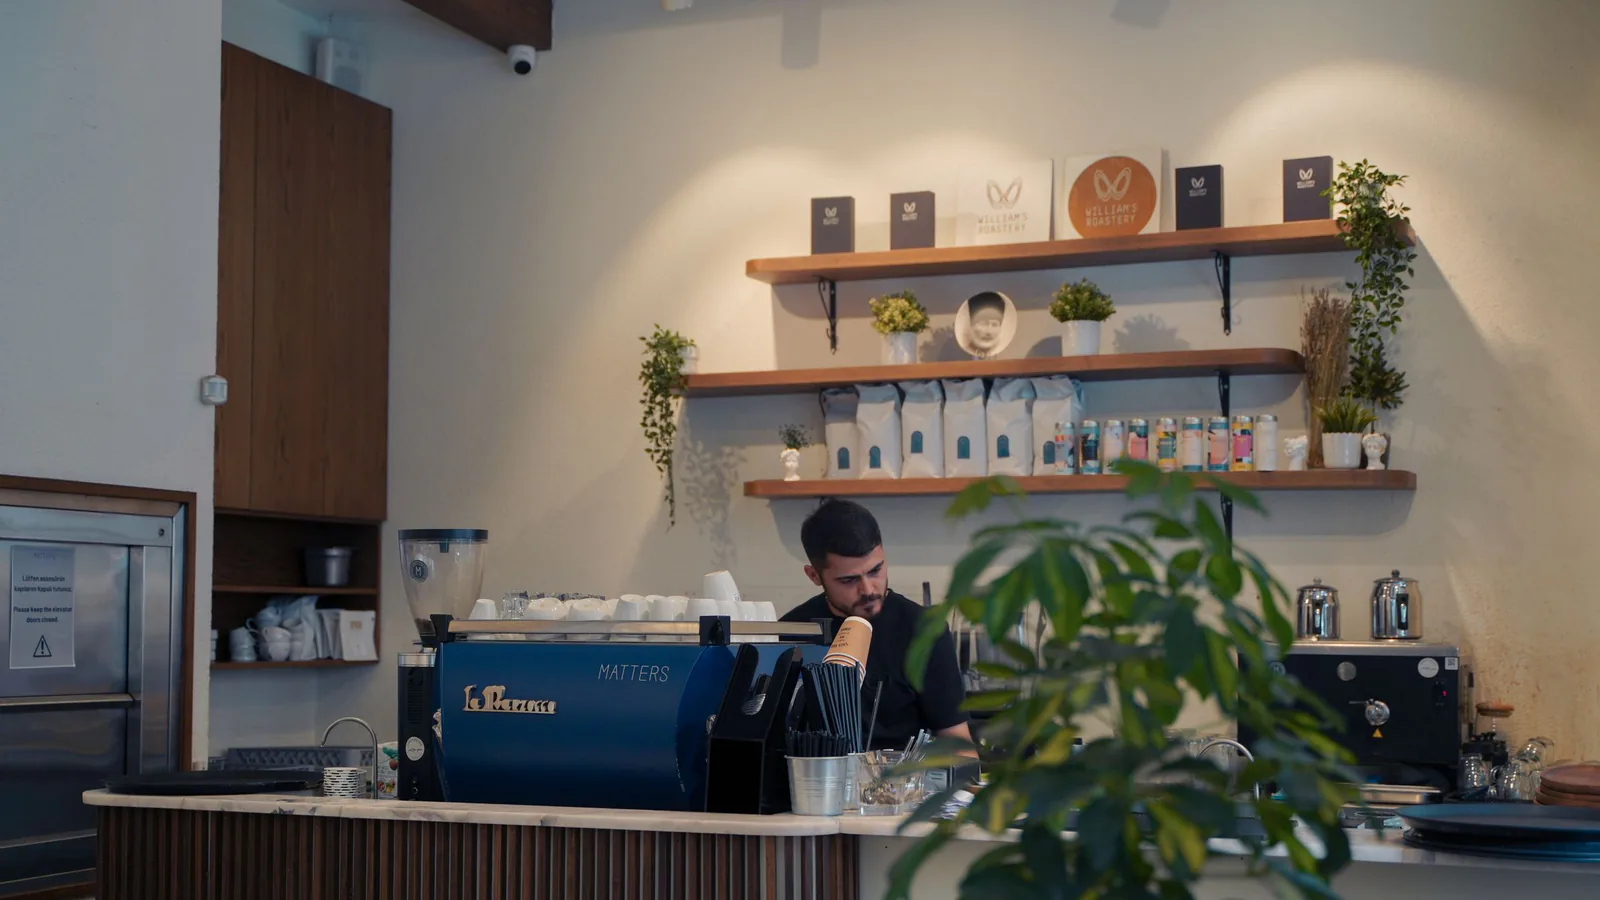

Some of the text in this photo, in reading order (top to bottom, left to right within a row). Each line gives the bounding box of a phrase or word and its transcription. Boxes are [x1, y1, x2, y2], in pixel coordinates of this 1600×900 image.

[1085, 203, 1137, 217] WILLIAM'S
[1086, 214, 1136, 227] ROASTERY
[598, 664, 670, 682] MATTERS
